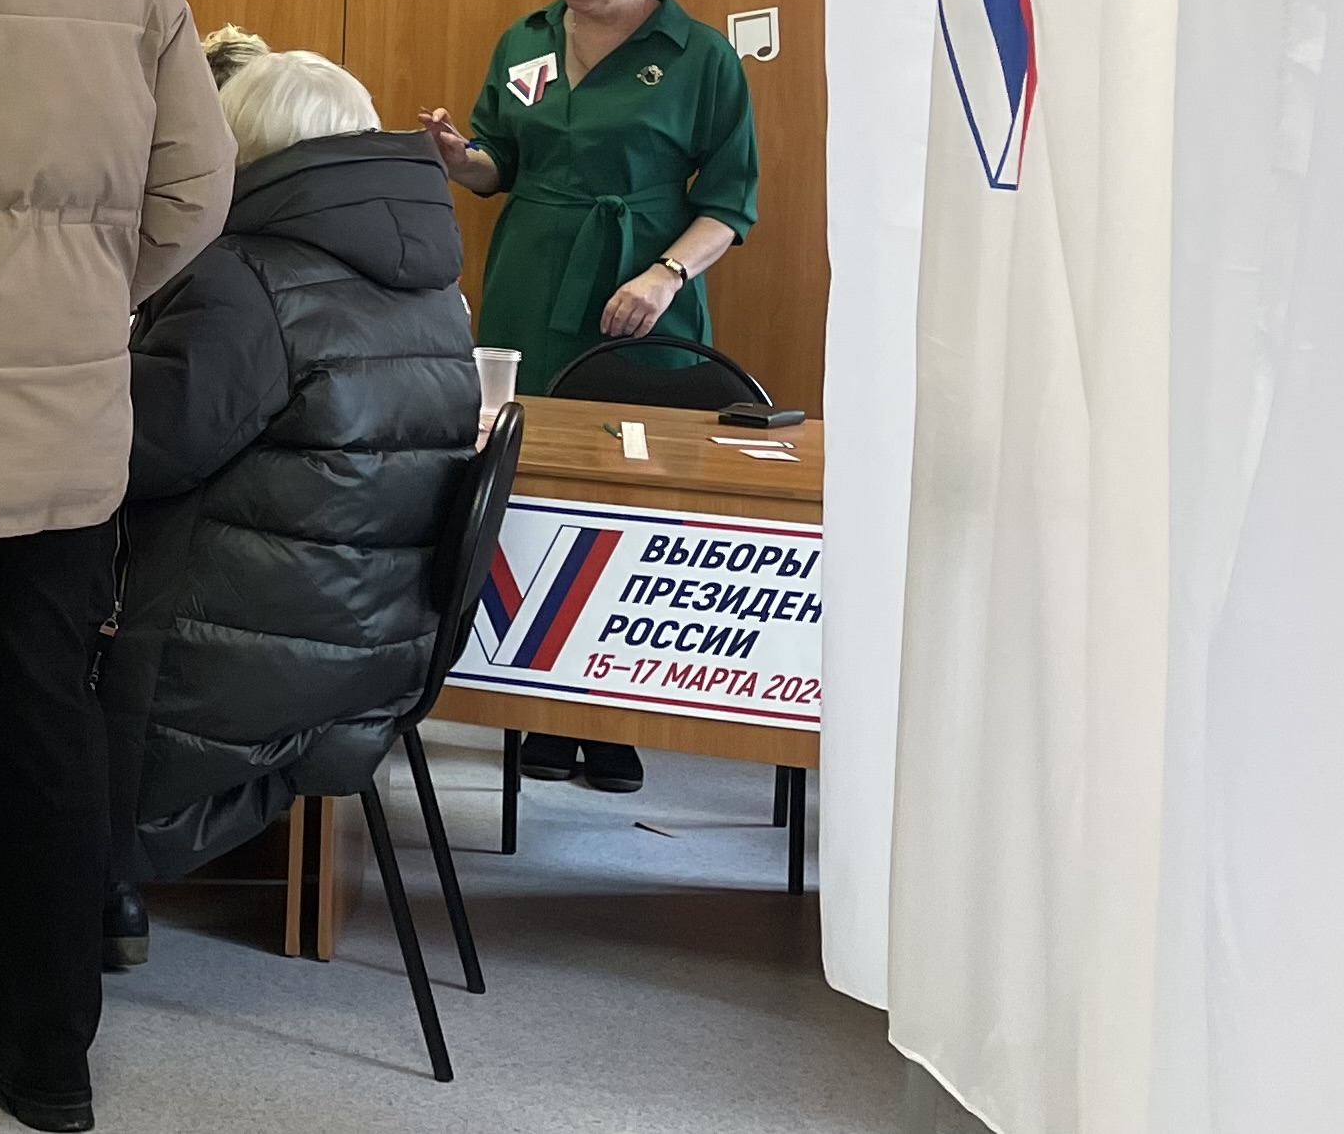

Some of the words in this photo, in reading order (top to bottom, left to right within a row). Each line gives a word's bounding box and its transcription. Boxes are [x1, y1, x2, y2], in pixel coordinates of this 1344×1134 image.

[640, 534, 821, 580] ВЫБОРЫ
[597, 613, 761, 659] РОССИИ
[661, 661, 759, 698] МАРТА
